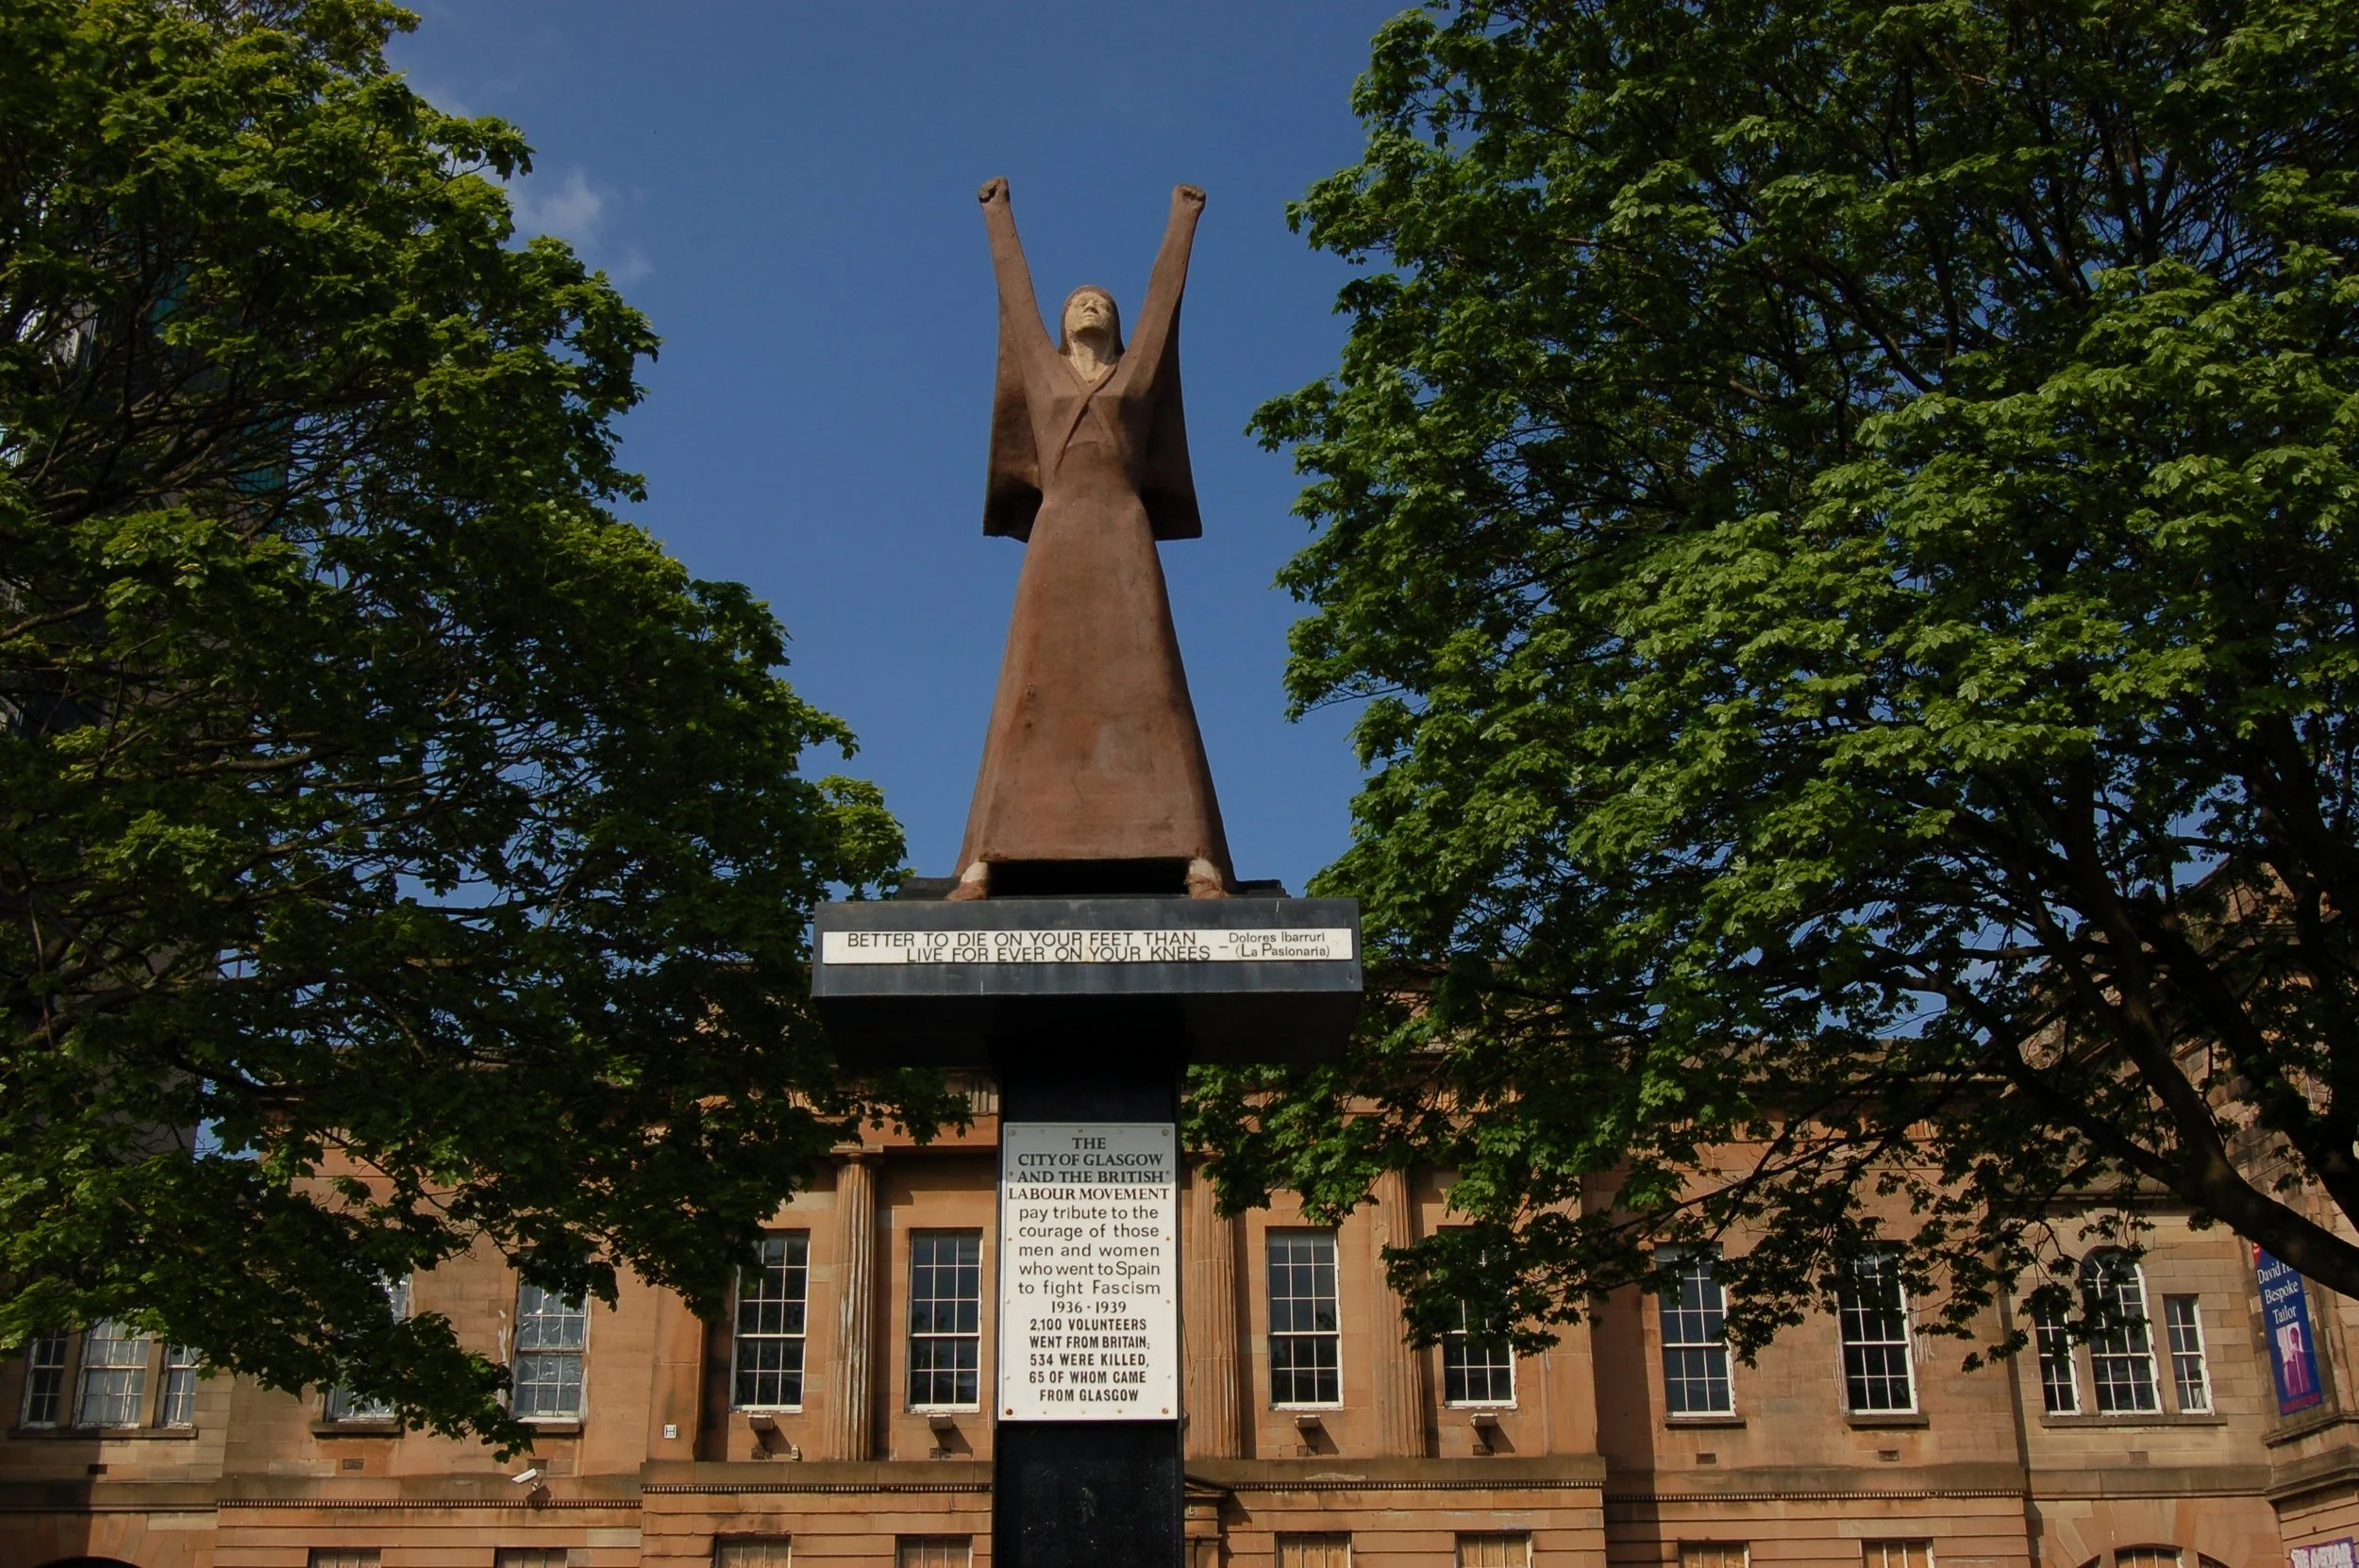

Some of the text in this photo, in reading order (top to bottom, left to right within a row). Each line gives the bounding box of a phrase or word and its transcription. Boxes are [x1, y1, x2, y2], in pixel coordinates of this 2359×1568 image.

[847, 931, 1196, 947] BETTER TO DIE ON YOUR FEET THAN
[1229, 932, 1277, 942] Dolores
[907, 948, 943, 962] LIVE
[952, 947, 988, 962] FOR
[997, 947, 1045, 961] EVER
[1055, 946, 1082, 961] ON
[1090, 946, 1141, 961] YOUR
[1150, 945, 1210, 960] KNEES
[1235, 942, 1330, 959] (La Pasionaria)
[1072, 1138, 1106, 1149] THE
[1018, 1154, 1163, 1166] CITY OF GLASGOW
[1017, 1171, 1163, 1183] AND THE BRITISH
[1009, 1188, 1170, 1200] LABOUR MOVEMENT
[1020, 1205, 1159, 1223] pay tribute to the
[1019, 1224, 1159, 1241] courage of those
[1019, 1243, 1160, 1257] men and women
[1019, 1260, 1160, 1279] who went to Spain
[2257, 1260, 2282, 1284] David
[1018, 1279, 1160, 1297] to fight Fascism
[2265, 1279, 2299, 1305] Bespoke
[1051, 1301, 1082, 1313] 1936
[1096, 1301, 1127, 1313] 1939
[2272, 1305, 2297, 1325] Tailor
[1029, 1319, 1146, 1331] 2,100 VOLUNTEERS
[1029, 1336, 1062, 1348] WENT
[1066, 1336, 1098, 1348] FROM
[1030, 1354, 1149, 1367] 534 WERE KILLED,
[1029, 1371, 1146, 1383] 65 OF WHOM CAME
[1040, 1390, 1139, 1401] FROM GLASGOW
